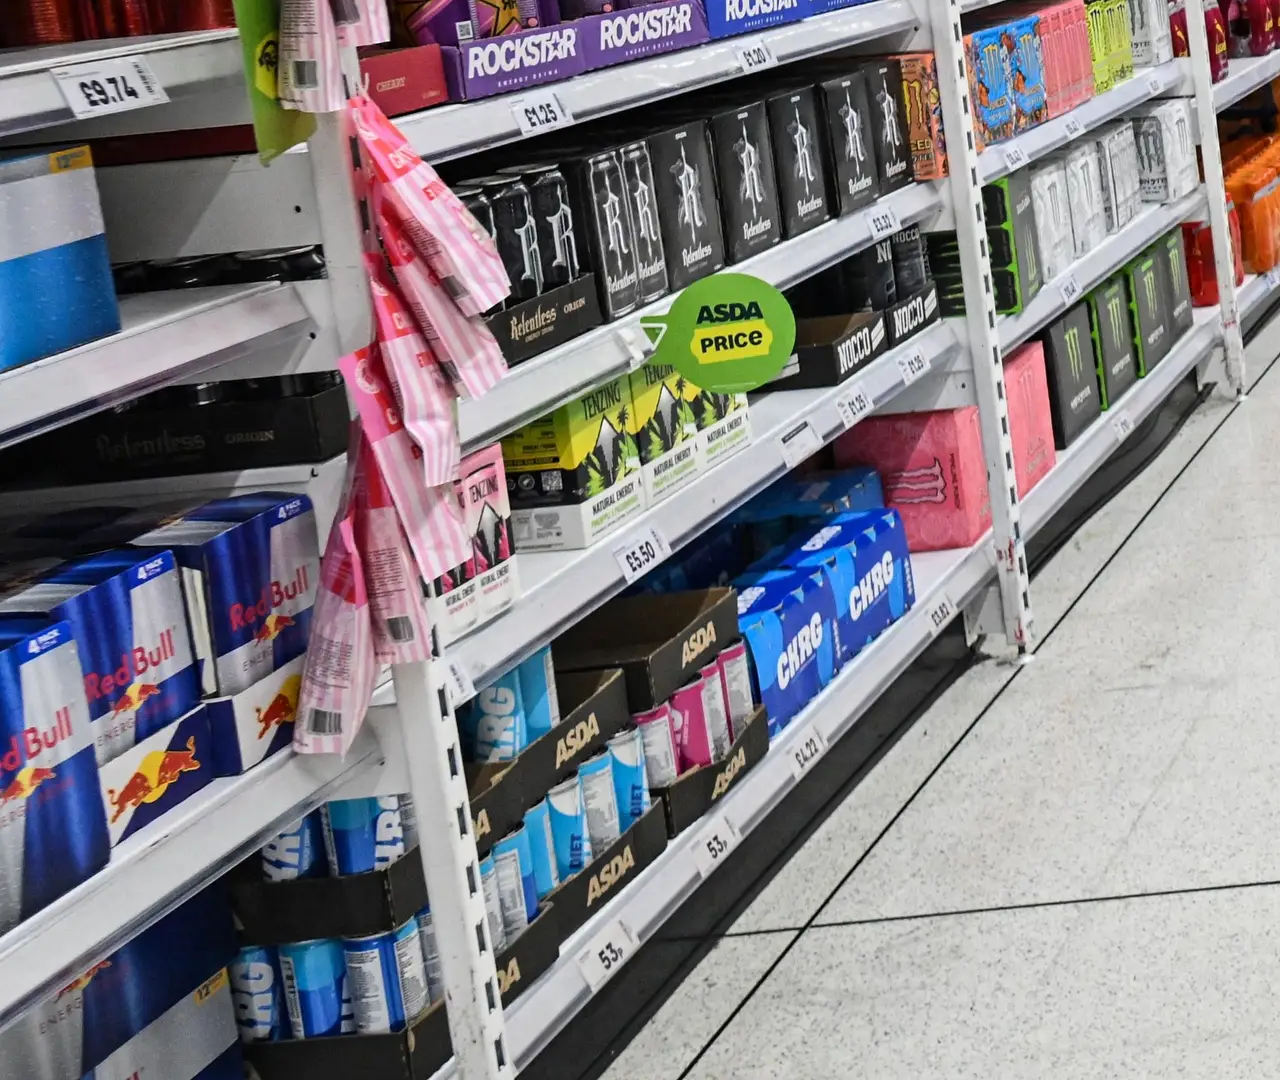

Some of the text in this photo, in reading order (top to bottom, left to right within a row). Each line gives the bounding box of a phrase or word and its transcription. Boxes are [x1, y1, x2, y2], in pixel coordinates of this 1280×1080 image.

[600, 4, 693, 51] ROCKSTAR
[468, 28, 577, 79] ROCKSTAR
[744, 45, 768, 68] £1.20
[78, 76, 140, 108] £9.74
[375, 76, 406, 92] CHERRY
[523, 104, 558, 131] £1.25
[743, 217, 773, 241] Relentless
[510, 306, 558, 340] Relentless
[695, 301, 765, 325] ASDA
[892, 296, 924, 339] NOCCO
[837, 326, 871, 375] NOCCO
[581, 381, 621, 420] TENZING
[625, 541, 655, 573] £5.50
[229, 565, 310, 632] Red Bull
[849, 550, 895, 621] CHRG
[83, 627, 176, 705] Red Bull
[681, 622, 717, 670] ASDA
[776, 611, 823, 690] CHRG
[22, 706, 74, 758] Bull
[555, 712, 600, 769] ASDA
[711, 748, 746, 801] ASDA
[630, 783, 643, 818] DIET
[569, 833, 582, 870] DIET
[706, 834, 728, 860] 53p
[586, 845, 636, 907] ASDA
[598, 941, 624, 970] 53p
